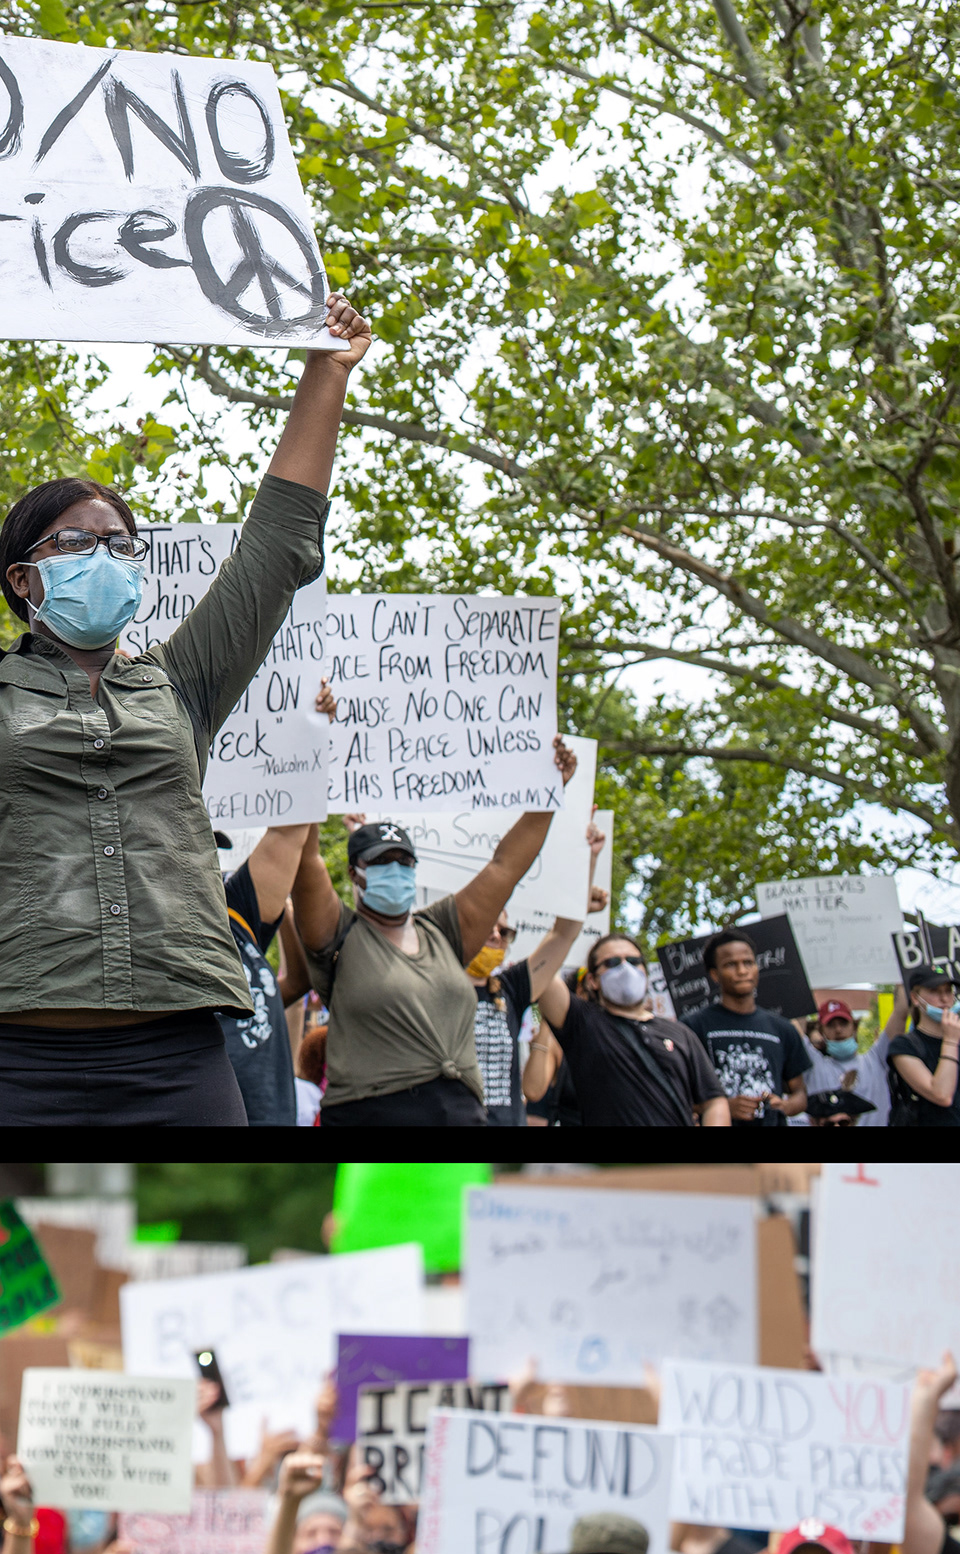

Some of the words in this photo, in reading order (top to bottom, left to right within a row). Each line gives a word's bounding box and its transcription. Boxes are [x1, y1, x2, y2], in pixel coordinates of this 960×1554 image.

[263, 620, 323, 667] HAT'S
[326, 613, 358, 639] OU
[326, 654, 370, 684] ACE
[379, 644, 433, 684] FROM
[445, 643, 549, 684] FREEDOM
[267, 671, 300, 712] ON
[332, 694, 395, 728] CAUSE
[498, 684, 543, 722] CAN
[389, 727, 457, 764] PEACE
[344, 768, 383, 804] HAS
[545, 787, 561, 808] X
[673, 1370, 816, 1443] WOULD
[828, 1379, 911, 1443] YOU
[465, 1418, 662, 1500] DEFUND
